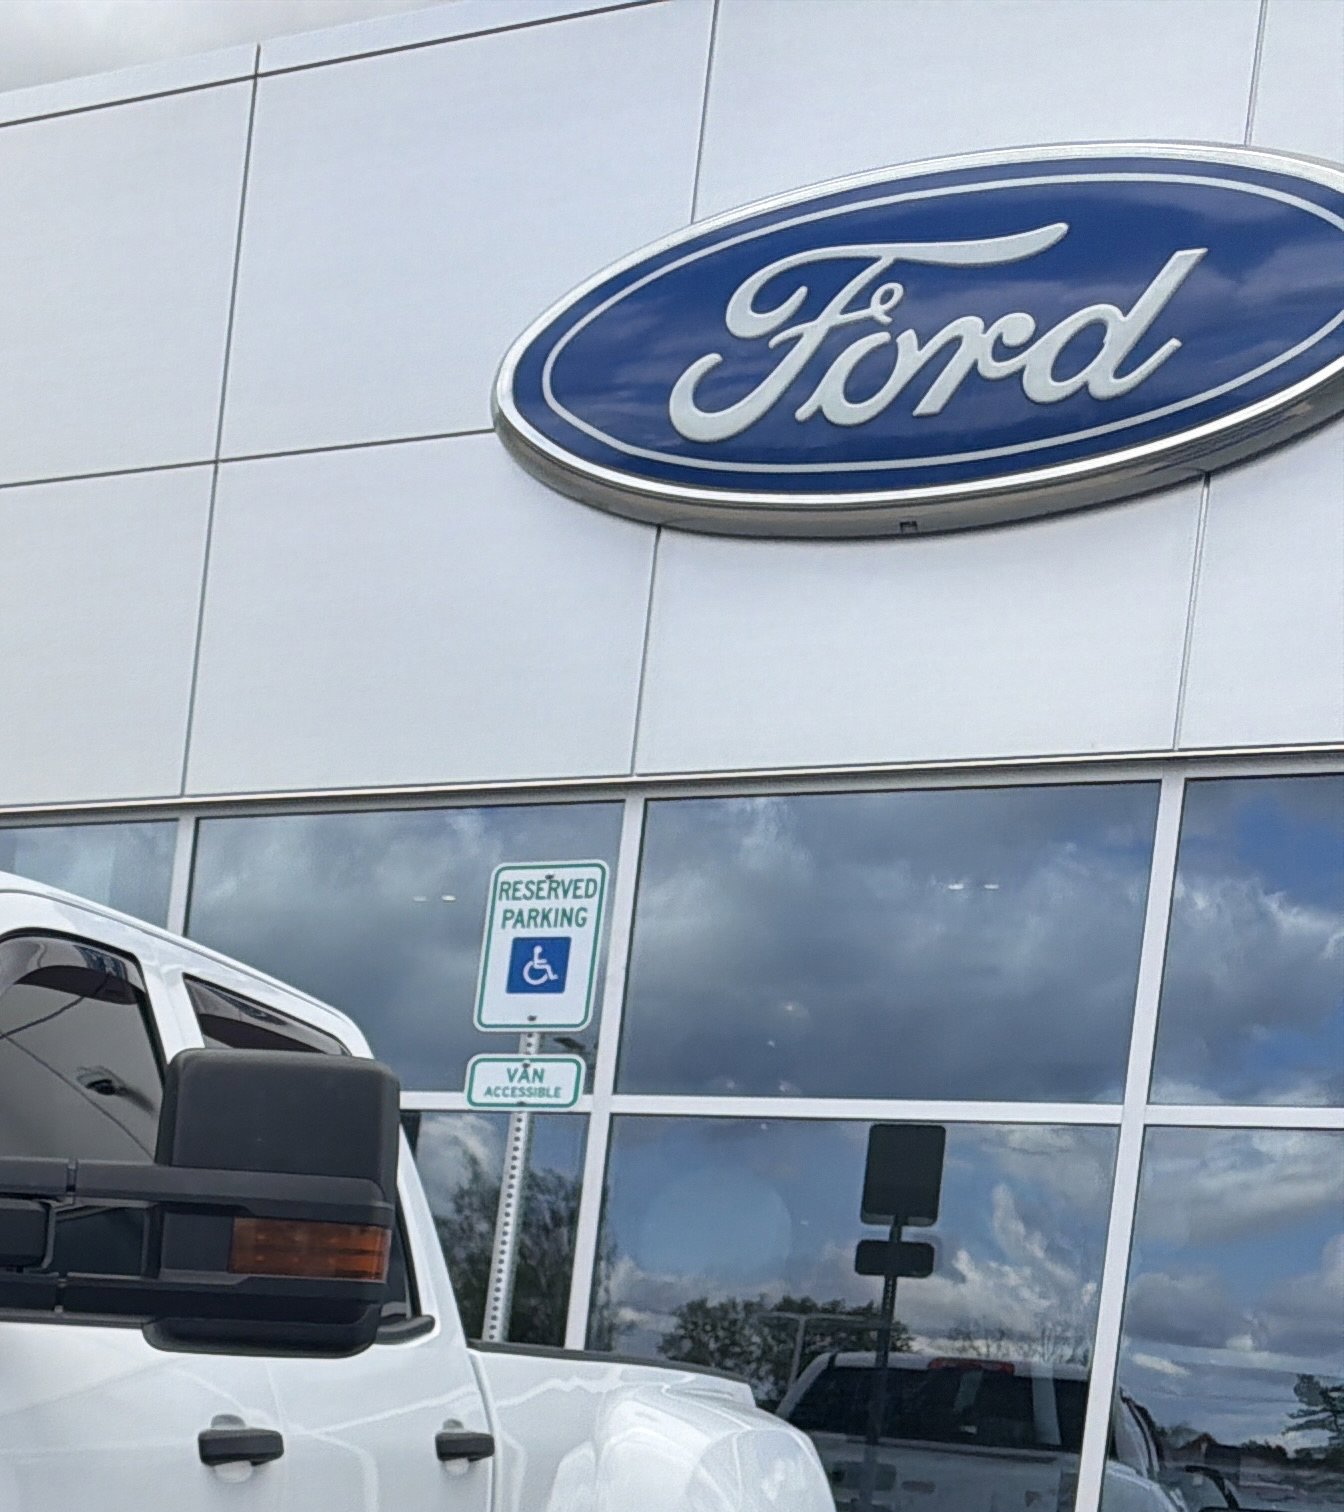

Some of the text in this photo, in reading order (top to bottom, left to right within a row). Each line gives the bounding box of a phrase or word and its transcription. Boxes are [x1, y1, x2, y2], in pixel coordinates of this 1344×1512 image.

[668, 221, 1209, 444] Ford
[498, 878, 598, 902] RESERVED
[501, 907, 589, 929] PARKING
[506, 1067, 546, 1084] VAN
[483, 1086, 563, 1099] ACCESSIBLE
